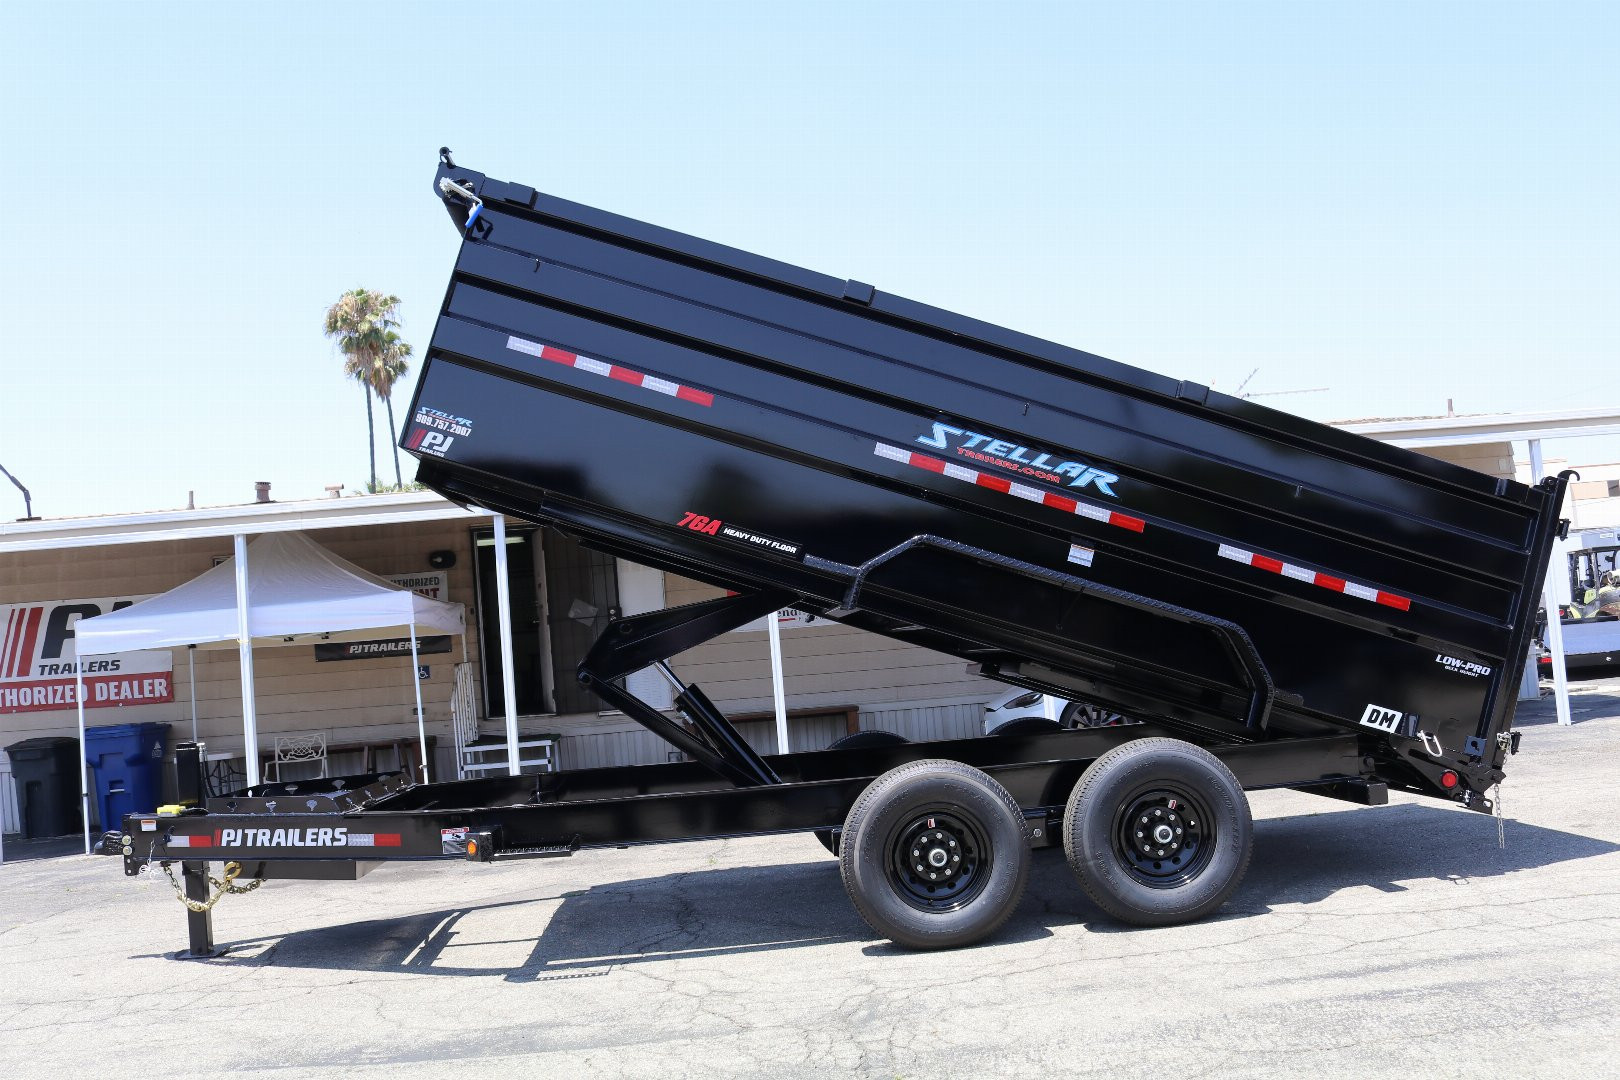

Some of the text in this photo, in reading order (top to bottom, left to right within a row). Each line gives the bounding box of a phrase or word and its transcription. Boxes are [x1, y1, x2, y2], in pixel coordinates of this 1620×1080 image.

[418, 406, 473, 428] STELLAR
[420, 431, 454, 453] PJ
[914, 421, 1120, 498] STELLAR
[676, 511, 722, 536] 7GA
[723, 527, 797, 554] HEAVY DUTY FLOOR
[1435, 654, 1491, 676] LOW-PRO
[95, 678, 168, 702] DEALER
[1366, 708, 1397, 729] DM
